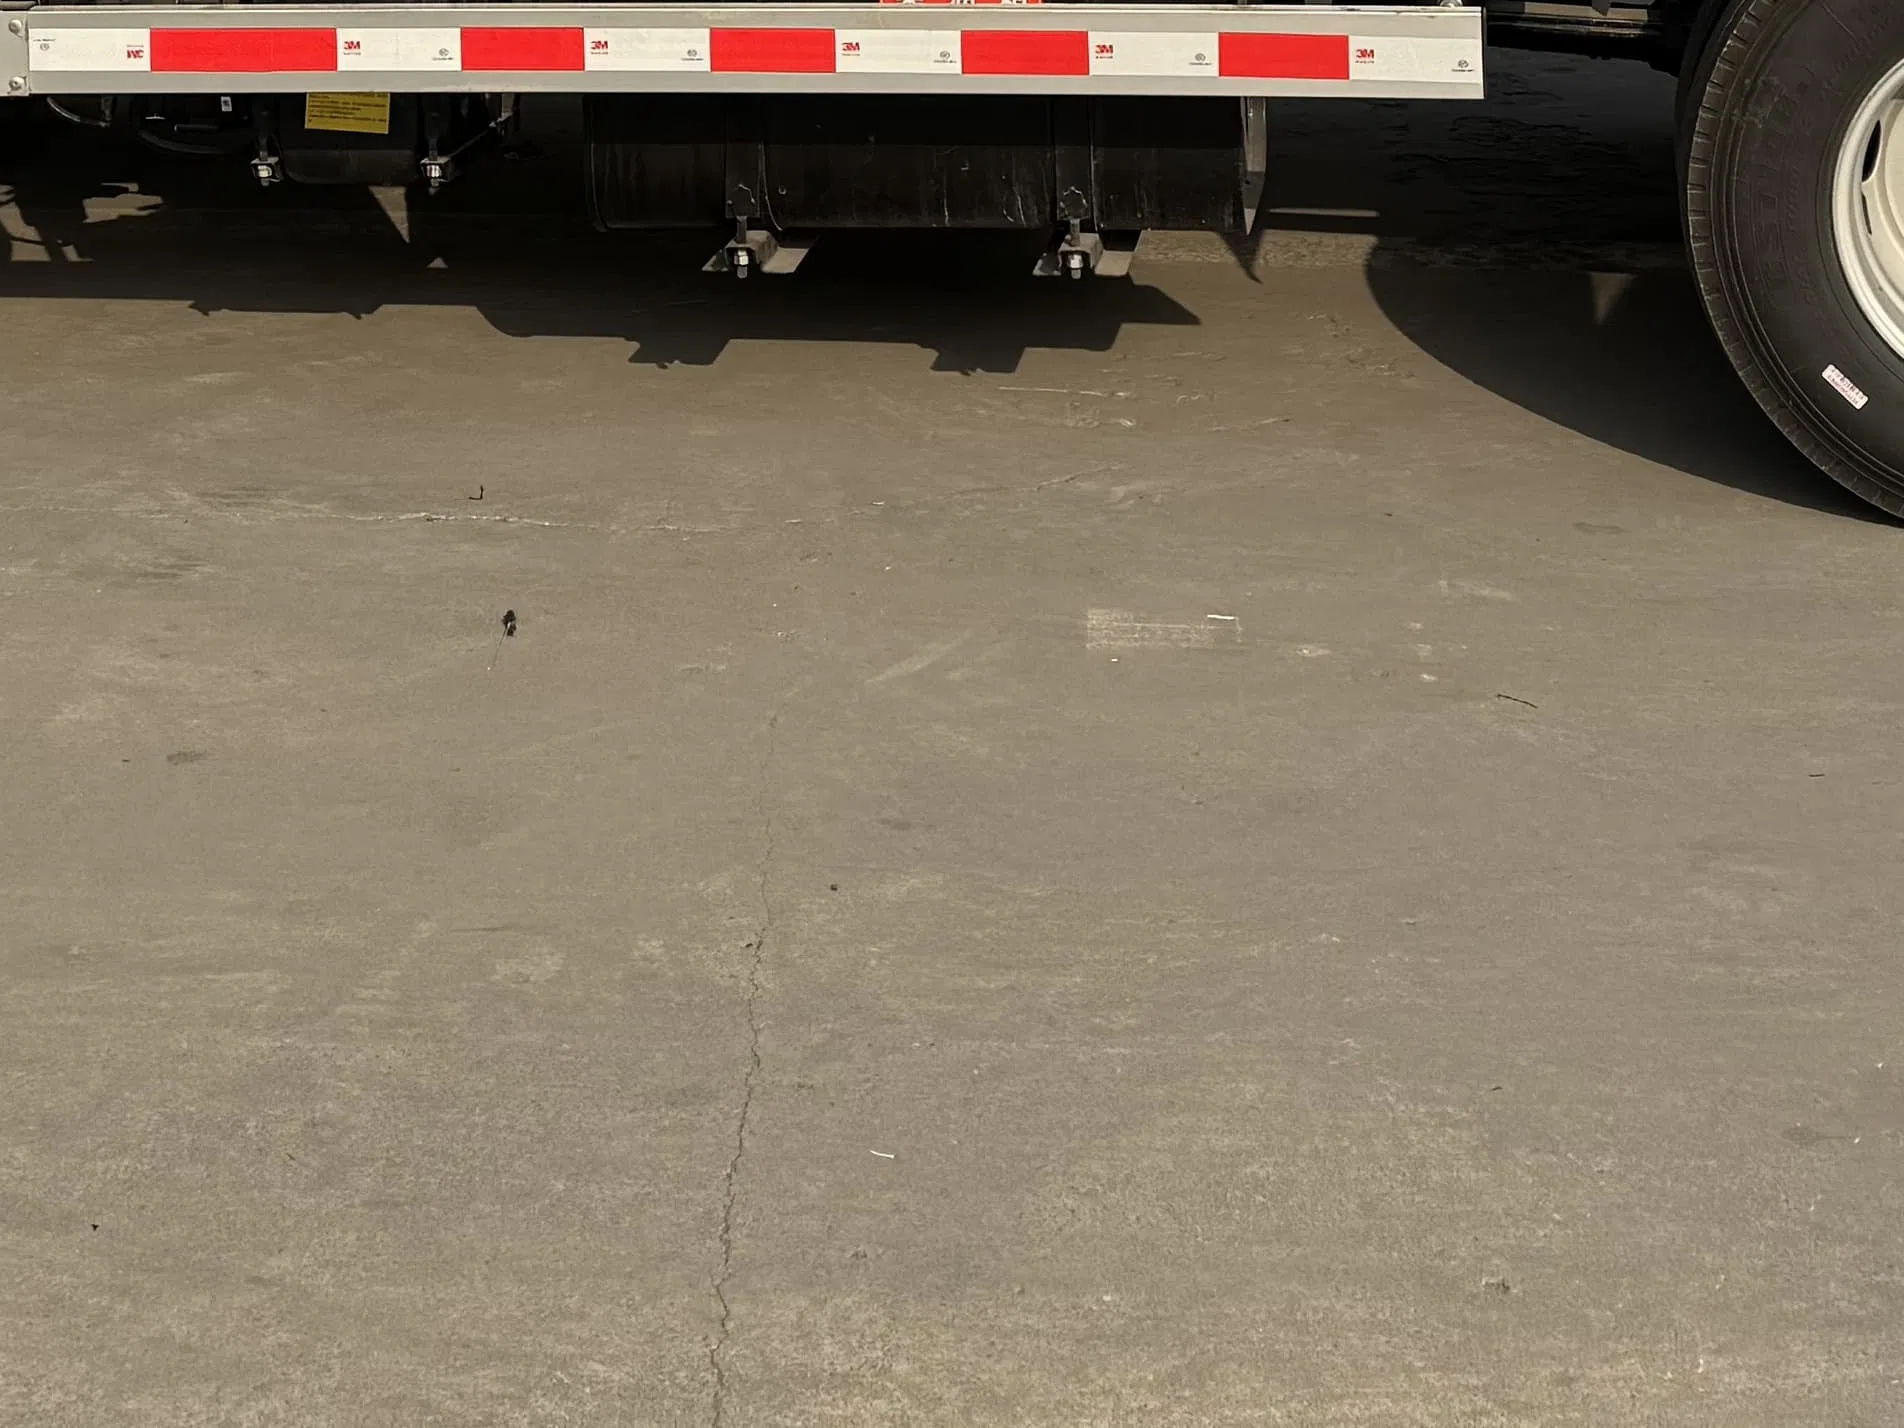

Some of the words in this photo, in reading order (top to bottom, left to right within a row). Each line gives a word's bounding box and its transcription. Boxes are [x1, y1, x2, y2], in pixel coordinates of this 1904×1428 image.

[842, 43, 859, 51] 3M
[1096, 44, 1113, 54] 3M
[1357, 49, 1374, 59] 3M
